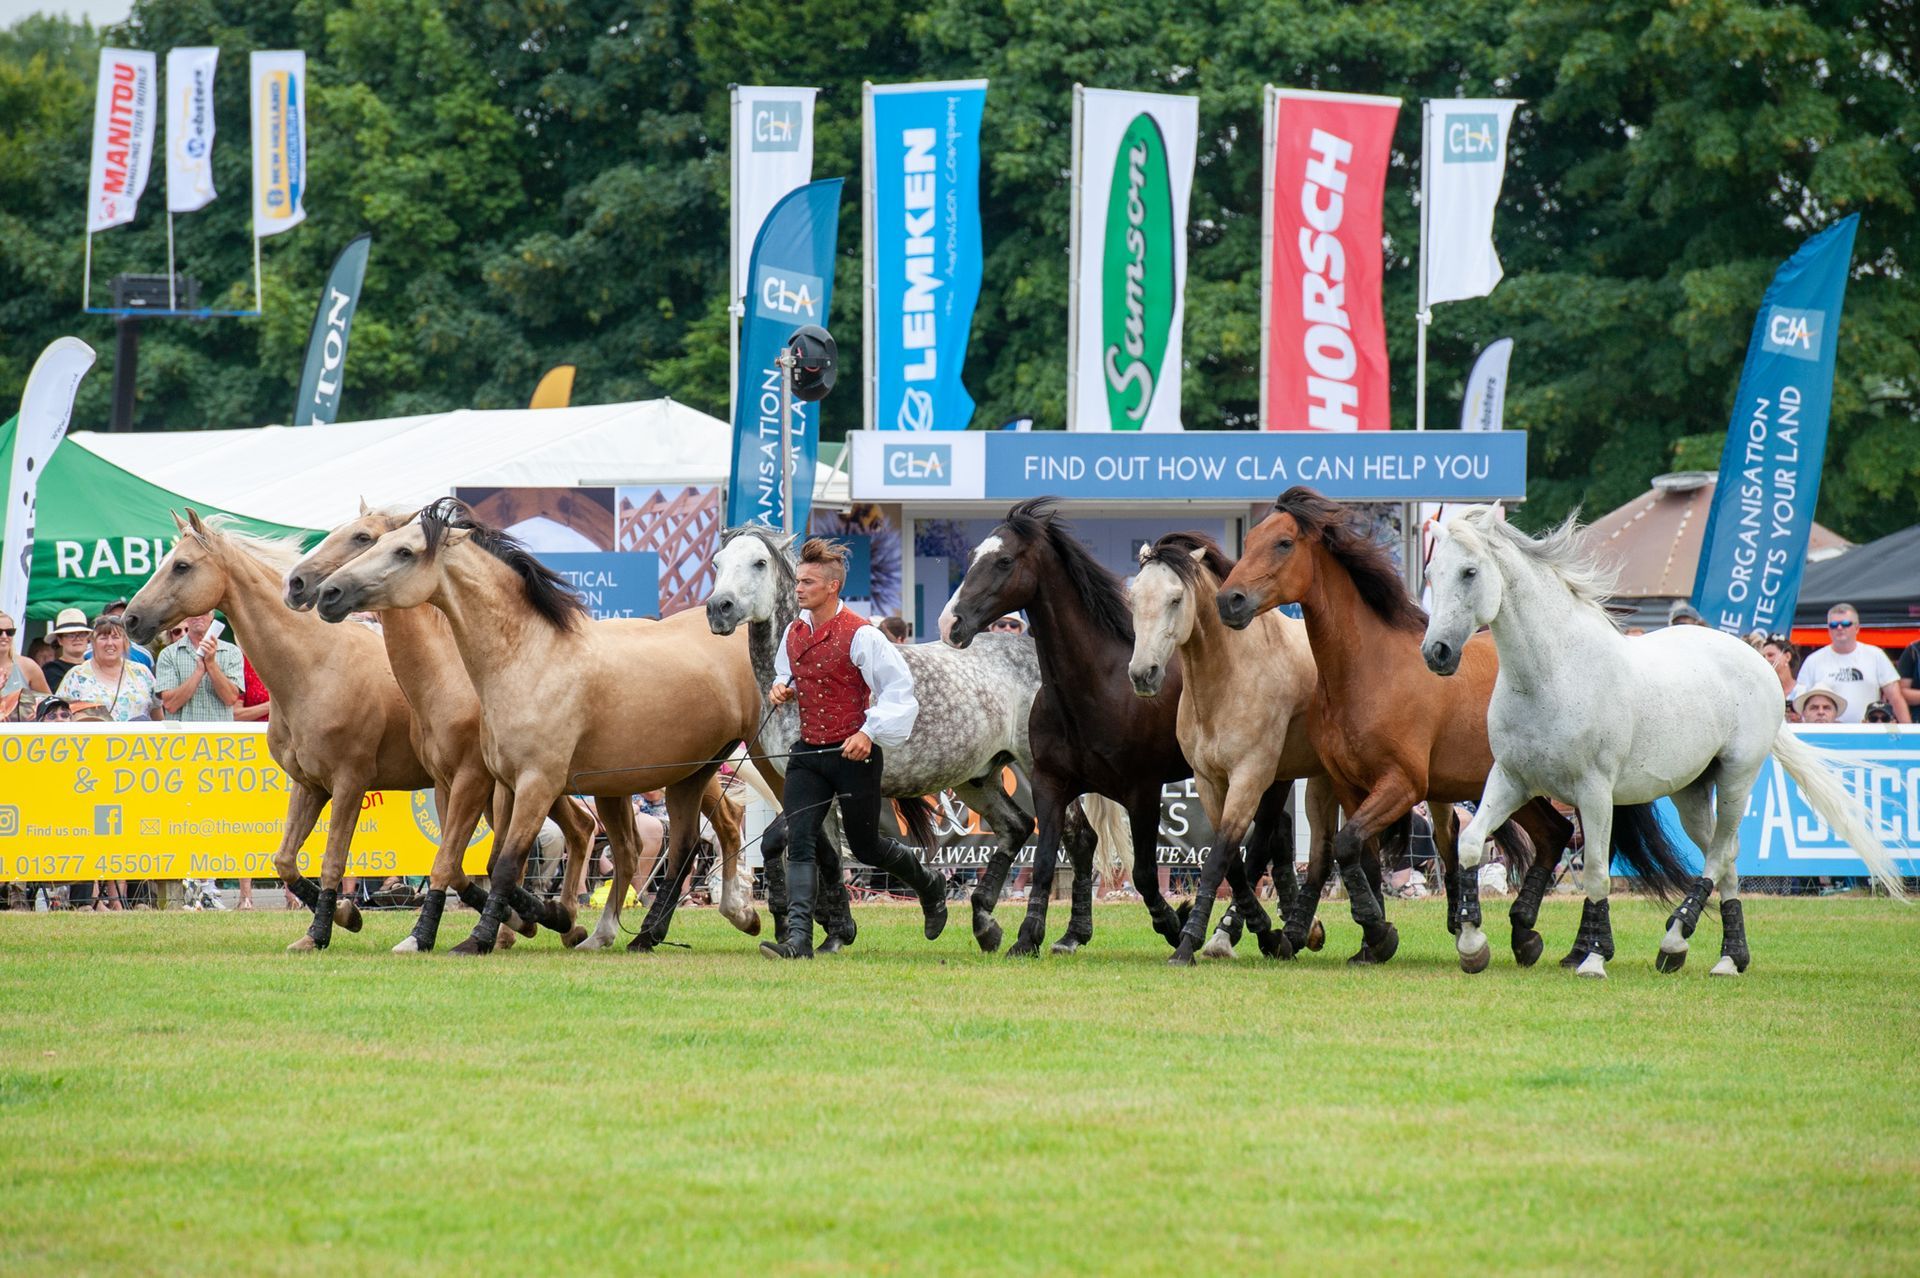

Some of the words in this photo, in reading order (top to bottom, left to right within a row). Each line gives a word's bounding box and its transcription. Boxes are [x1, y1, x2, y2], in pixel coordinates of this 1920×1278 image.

[103, 63, 136, 194] MANITOU
[756, 110, 793, 143] CLA
[1449, 122, 1494, 154] CLA
[902, 128, 945, 382] LEMKEN
[763, 276, 814, 317] CLA
[1106, 138, 1154, 421] Samson
[1298, 127, 1358, 431] HORSCH
[1770, 314, 1811, 350] CLA
[311, 285, 351, 426] TON
[1775, 385, 1801, 463] LAND
[889, 451, 943, 478] CLA
[1025, 456, 1086, 480] FIND
[1095, 456, 1150, 481] OUT
[1158, 456, 1226, 481] HOW
[1236, 456, 1288, 481] CLA
[1297, 455, 1354, 480] CAN
[1363, 455, 1426, 480] HELP
[1434, 454, 1489, 480] YOU
[1727, 397, 1770, 603] ORGANISATION
[1770, 468, 1797, 539] YOUR
[2, 736, 90, 763] OGGY
[106, 735, 257, 762] DAYCARE
[73, 766, 99, 794] &
[114, 768, 184, 794] DOG
[26, 825, 51, 836] Find
[56, 826, 69, 836] us
[73, 825, 90, 837] on:
[16, 855, 85, 875] 01377
[95, 854, 176, 873] 455017
[190, 853, 240, 873] Mob.
[930, 846, 998, 863] AWAR
